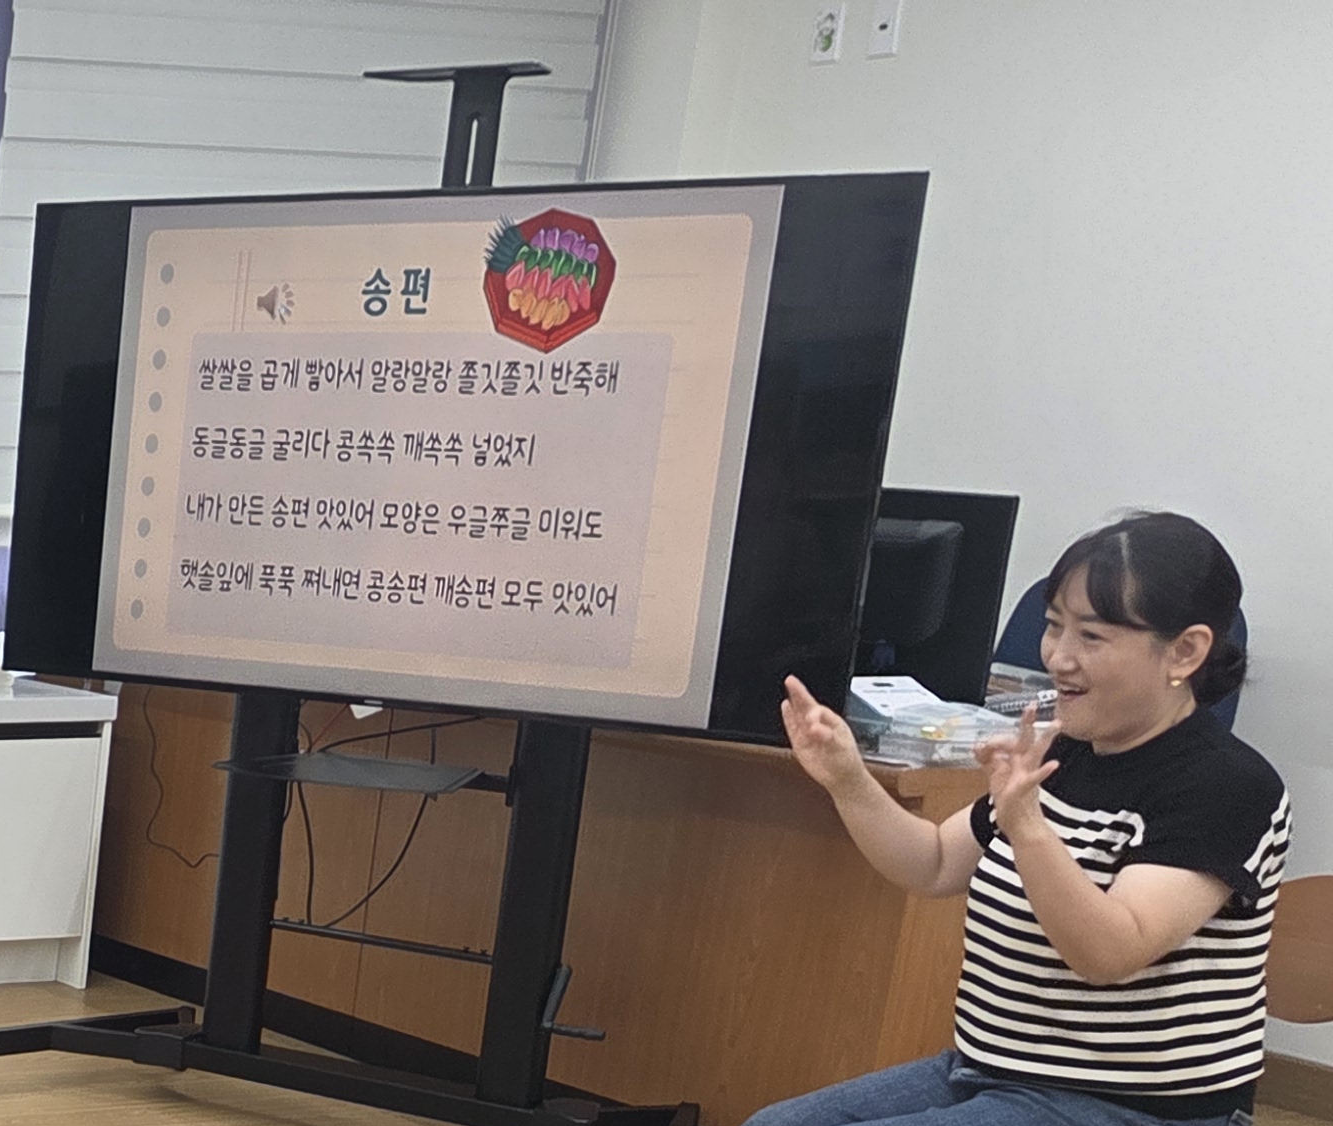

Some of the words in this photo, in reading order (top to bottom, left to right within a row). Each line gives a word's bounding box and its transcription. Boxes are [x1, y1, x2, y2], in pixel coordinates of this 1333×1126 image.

[199, 358, 254, 391] 쌀쌀을
[260, 358, 300, 391] 곱게
[305, 358, 364, 392] 빻아서
[371, 359, 452, 394] 말랑말랑
[458, 360, 543, 396] 쫄깃쫄깃
[551, 359, 619, 397] 반죽해
[192, 427, 266, 460] 동글동글
[272, 428, 330, 461] 굴리다
[336, 429, 395, 464] 콩쏙쏙
[403, 431, 463, 466] 깨쏙쏙
[472, 432, 535, 467] 넣었지
[186, 493, 222, 522] 내가
[229, 493, 264, 526] 만든
[271, 495, 310, 528] 송편
[316, 498, 374, 531] 맛있어
[380, 501, 440, 534] 모양은
[448, 505, 531, 541] 우글쭈글
[538, 507, 603, 541] 미워도
[181, 559, 254, 592] 햇솔잎에
[259, 564, 295, 597] 푹푹
[301, 566, 361, 600] 쪄내면
[367, 570, 427, 604] 콩송편
[434, 574, 496, 609] 깨송편
[501, 581, 543, 611] 모두
[552, 581, 618, 616] 맛있어
